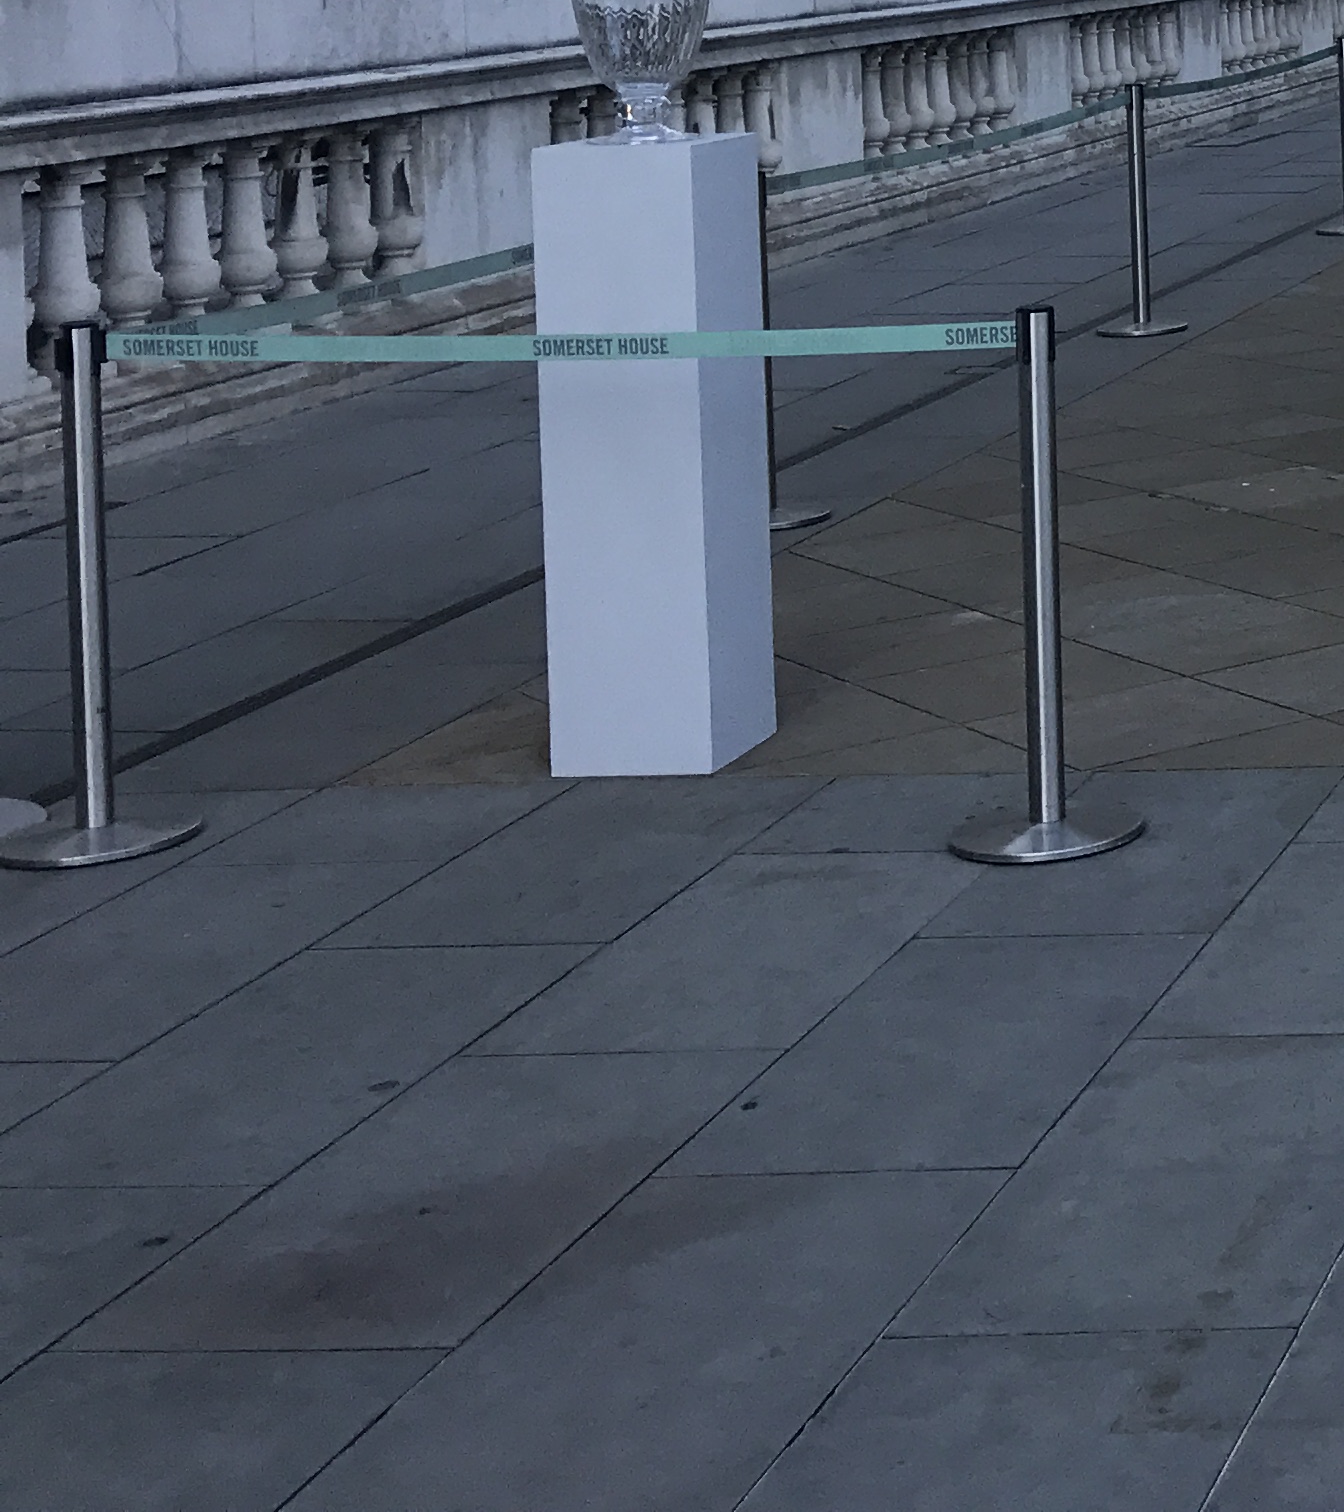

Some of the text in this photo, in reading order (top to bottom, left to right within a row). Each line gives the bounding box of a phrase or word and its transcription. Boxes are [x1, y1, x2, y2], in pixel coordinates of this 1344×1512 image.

[945, 326, 1017, 346] SOMERSE
[122, 338, 260, 357] SOMERSET HOUSE
[533, 338, 670, 356] SOMERSET HOUSE
